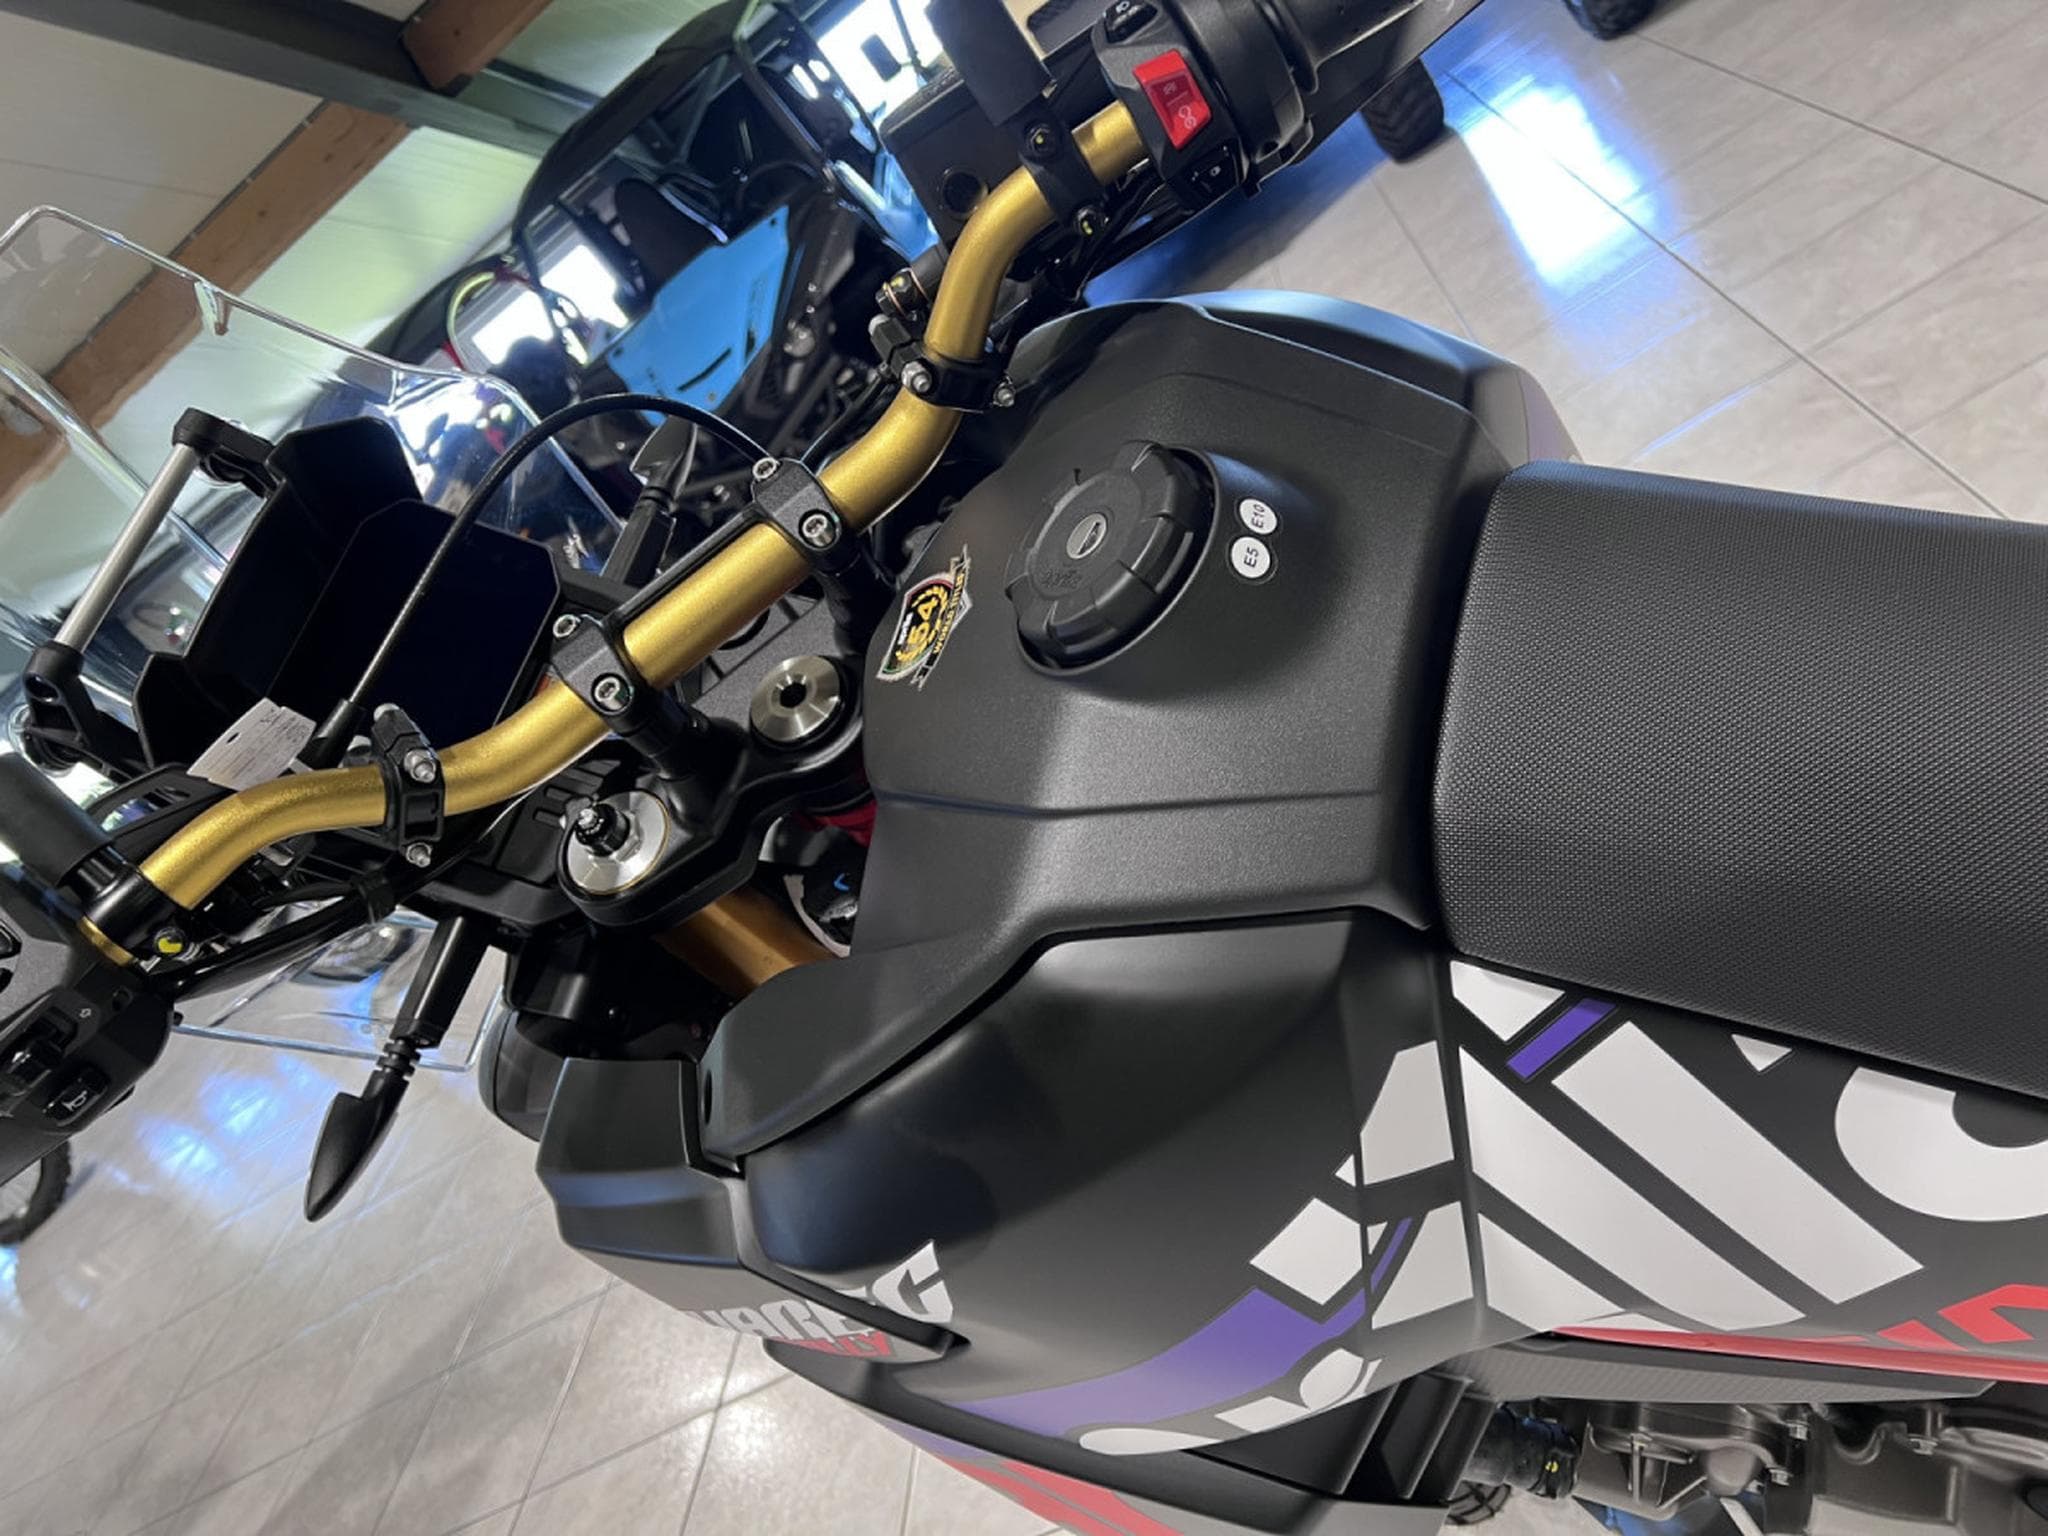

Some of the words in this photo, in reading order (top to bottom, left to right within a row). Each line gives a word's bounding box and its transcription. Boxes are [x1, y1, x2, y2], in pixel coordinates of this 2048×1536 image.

[1251, 503, 1265, 529] E10
[1243, 546, 1259, 568] E5
[907, 596, 939, 645] 54
